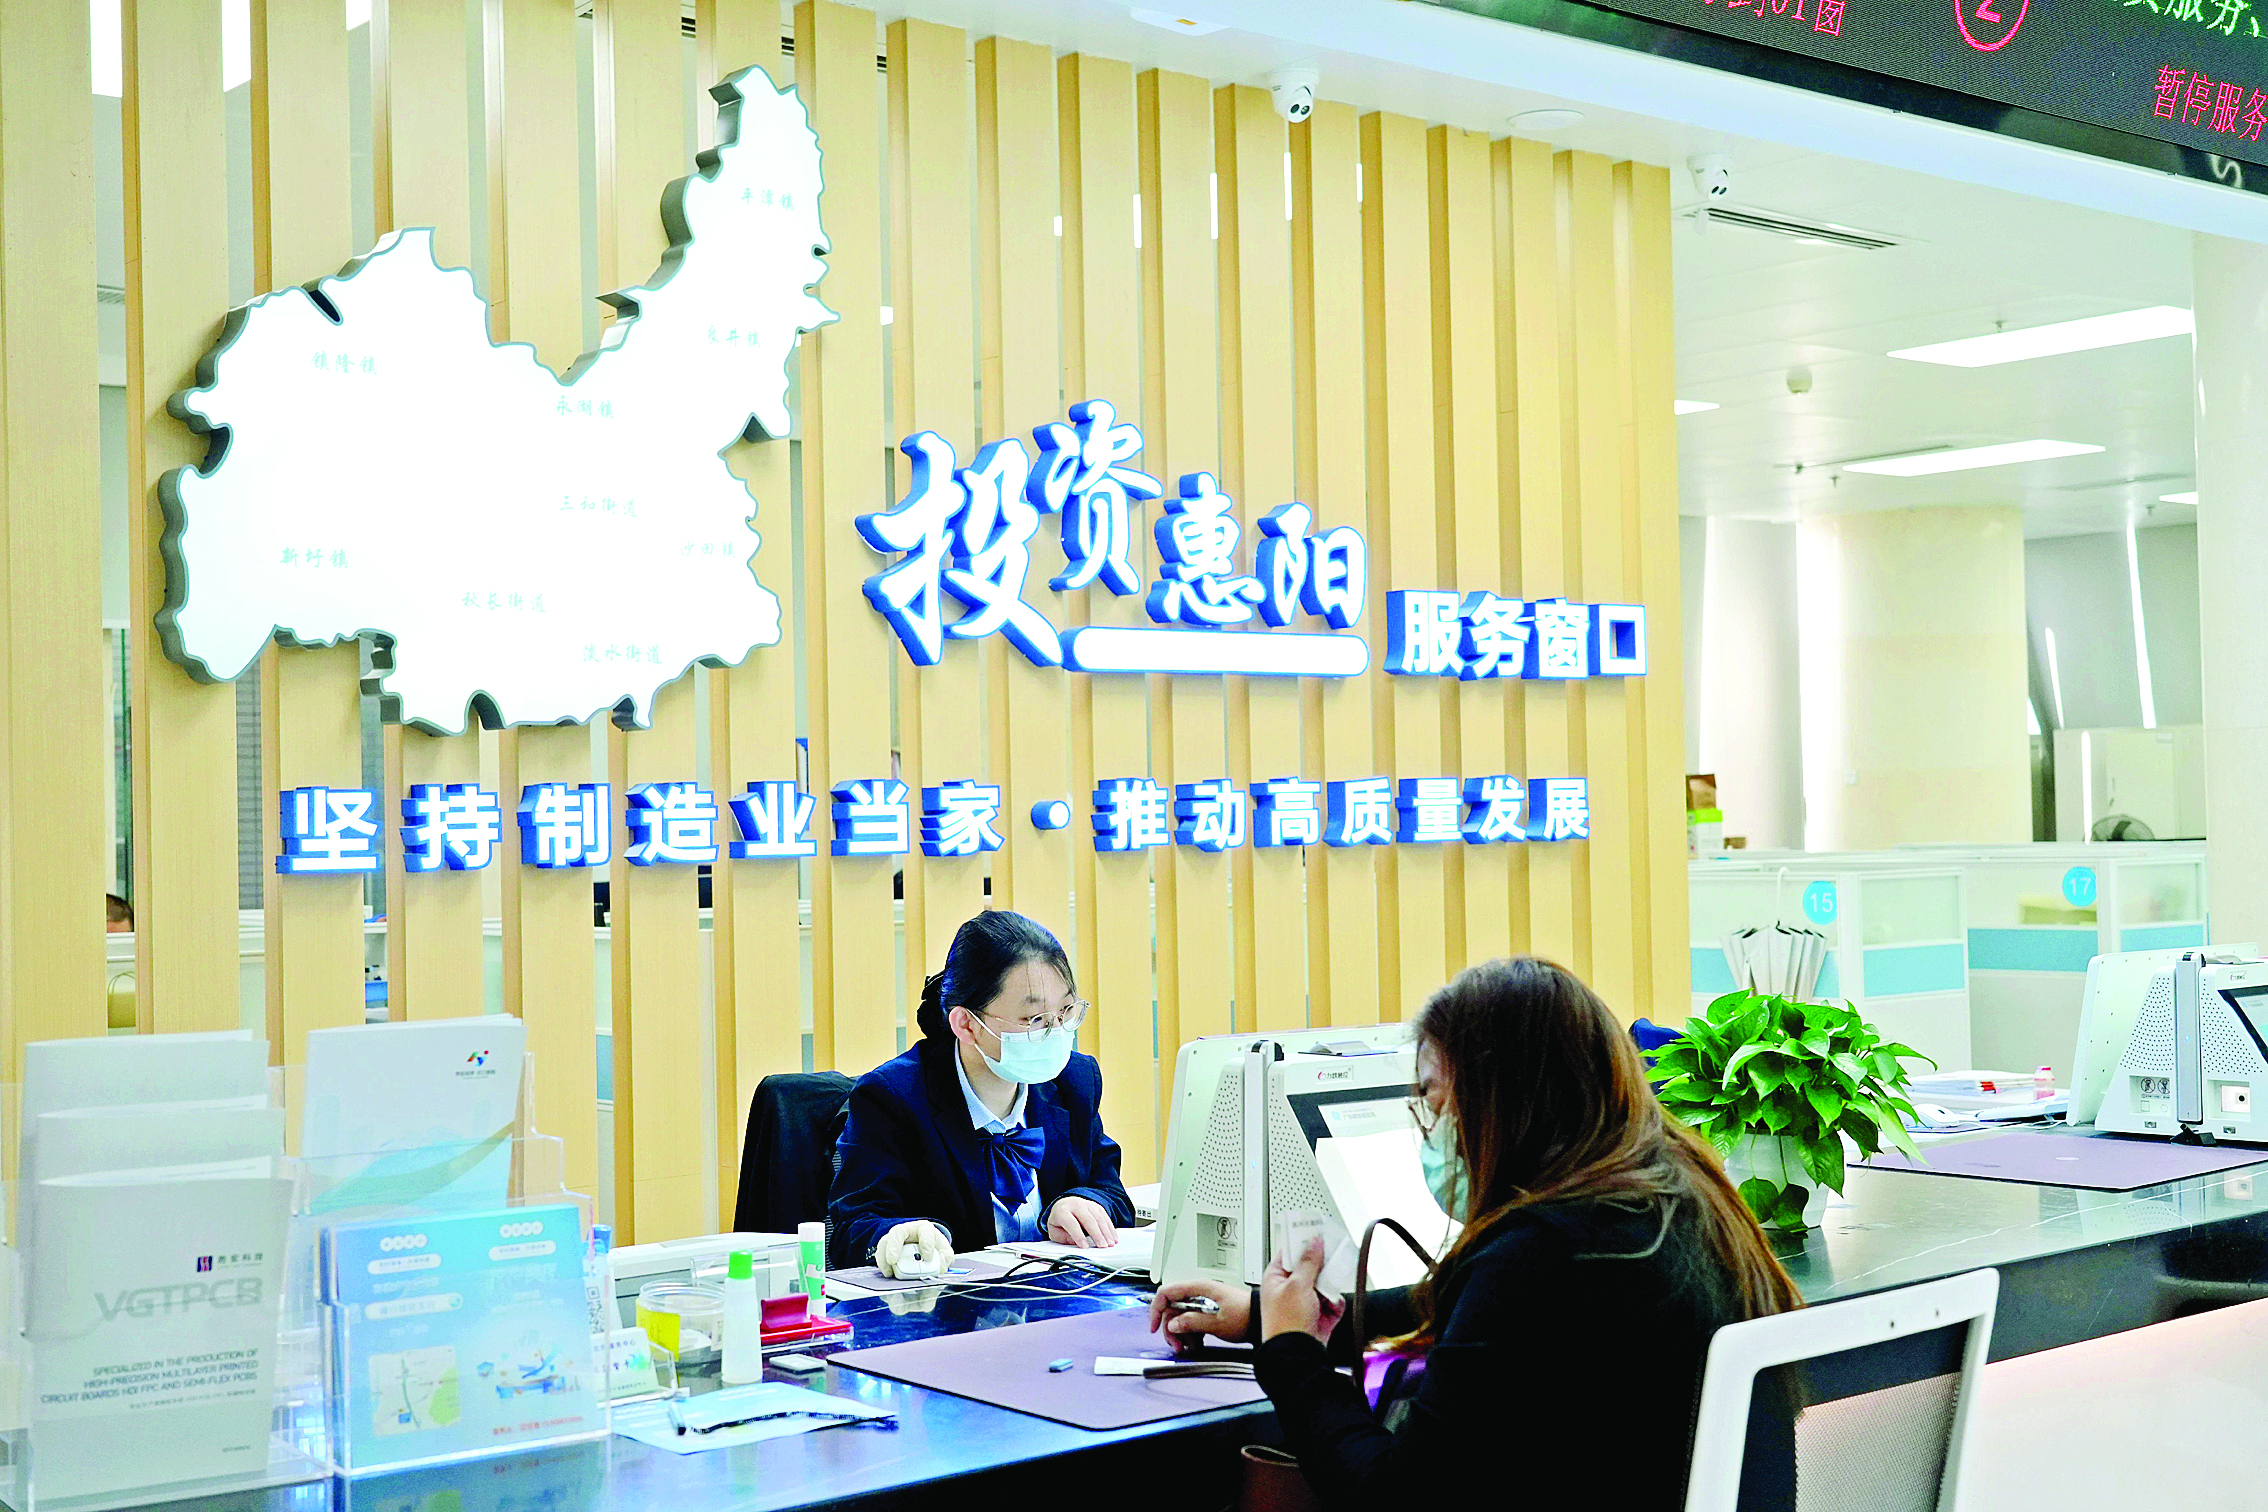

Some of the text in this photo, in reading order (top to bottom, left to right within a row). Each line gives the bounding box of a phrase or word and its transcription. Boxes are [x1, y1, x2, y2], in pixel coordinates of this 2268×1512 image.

[2154, 63, 2268, 142] 暂停服务
[741, 188, 794, 211] 平潭镇
[311, 351, 377, 375] 镇隆镇
[556, 395, 614, 419] 永湖镇
[560, 496, 637, 517] 三和街道
[855, 399, 1366, 667] 投资惠阳
[279, 547, 349, 569] 新圩镇
[679, 539, 737, 561] 沙田镇
[462, 591, 546, 612] 秋长街道
[1384, 590, 1647, 680] 服务窗口
[583, 644, 662, 664] 淡水街道
[2069, 877, 2091, 896] 17
[1809, 892, 1834, 913] 15
[94, 1277, 263, 1321] VGTPCB
